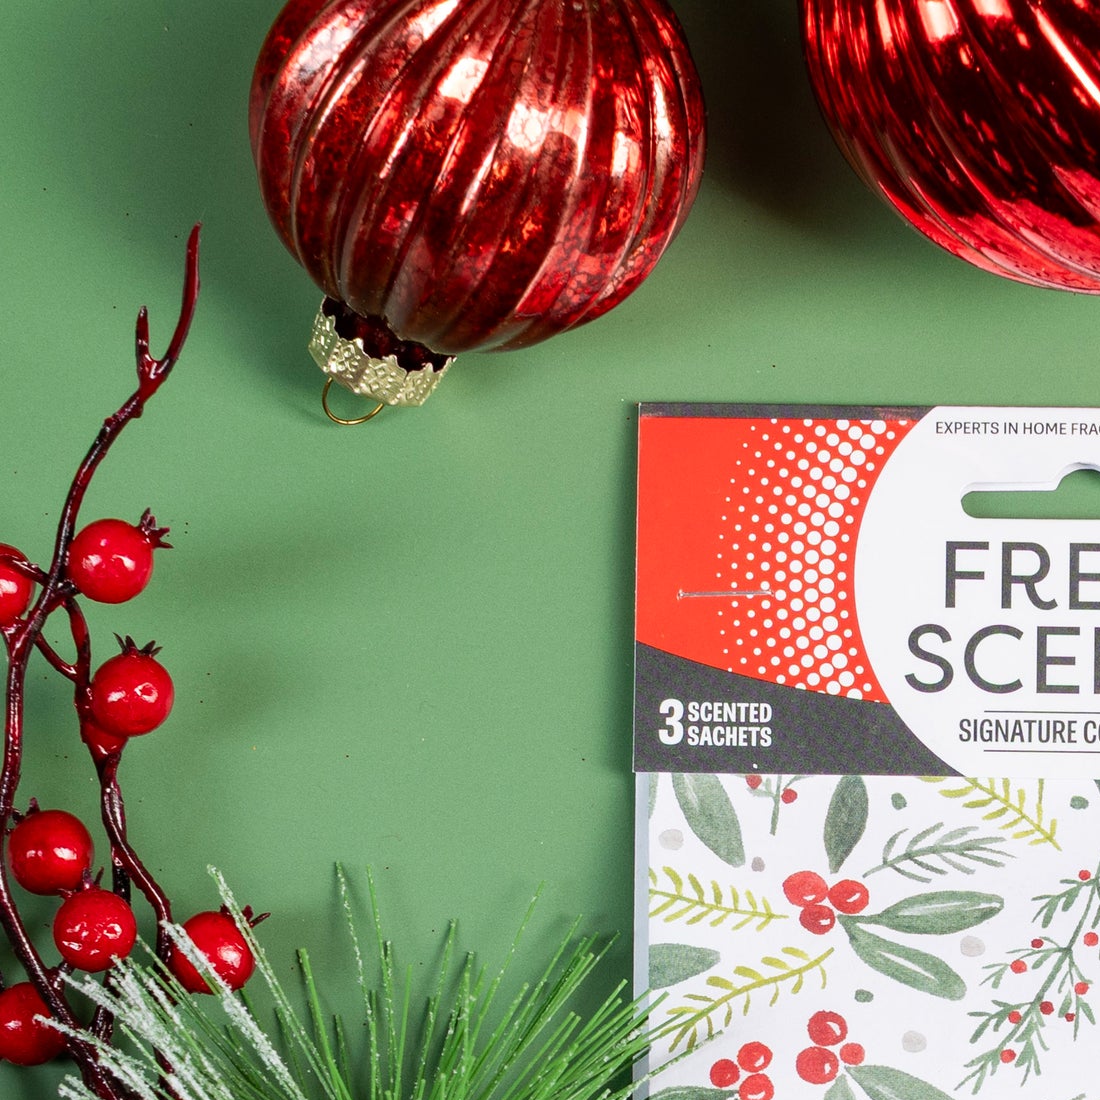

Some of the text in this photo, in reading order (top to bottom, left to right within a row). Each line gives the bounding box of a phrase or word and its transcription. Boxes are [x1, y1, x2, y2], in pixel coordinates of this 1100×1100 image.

[935, 420, 999, 436] EXPERTS
[1002, 420, 1018, 436] IN
[1022, 421, 1067, 436] HOME
[658, 698, 684, 745] 3
[687, 702, 772, 723] SCENTED
[687, 726, 772, 747] SACHETS
[958, 718, 1077, 744] SIGNATURE
